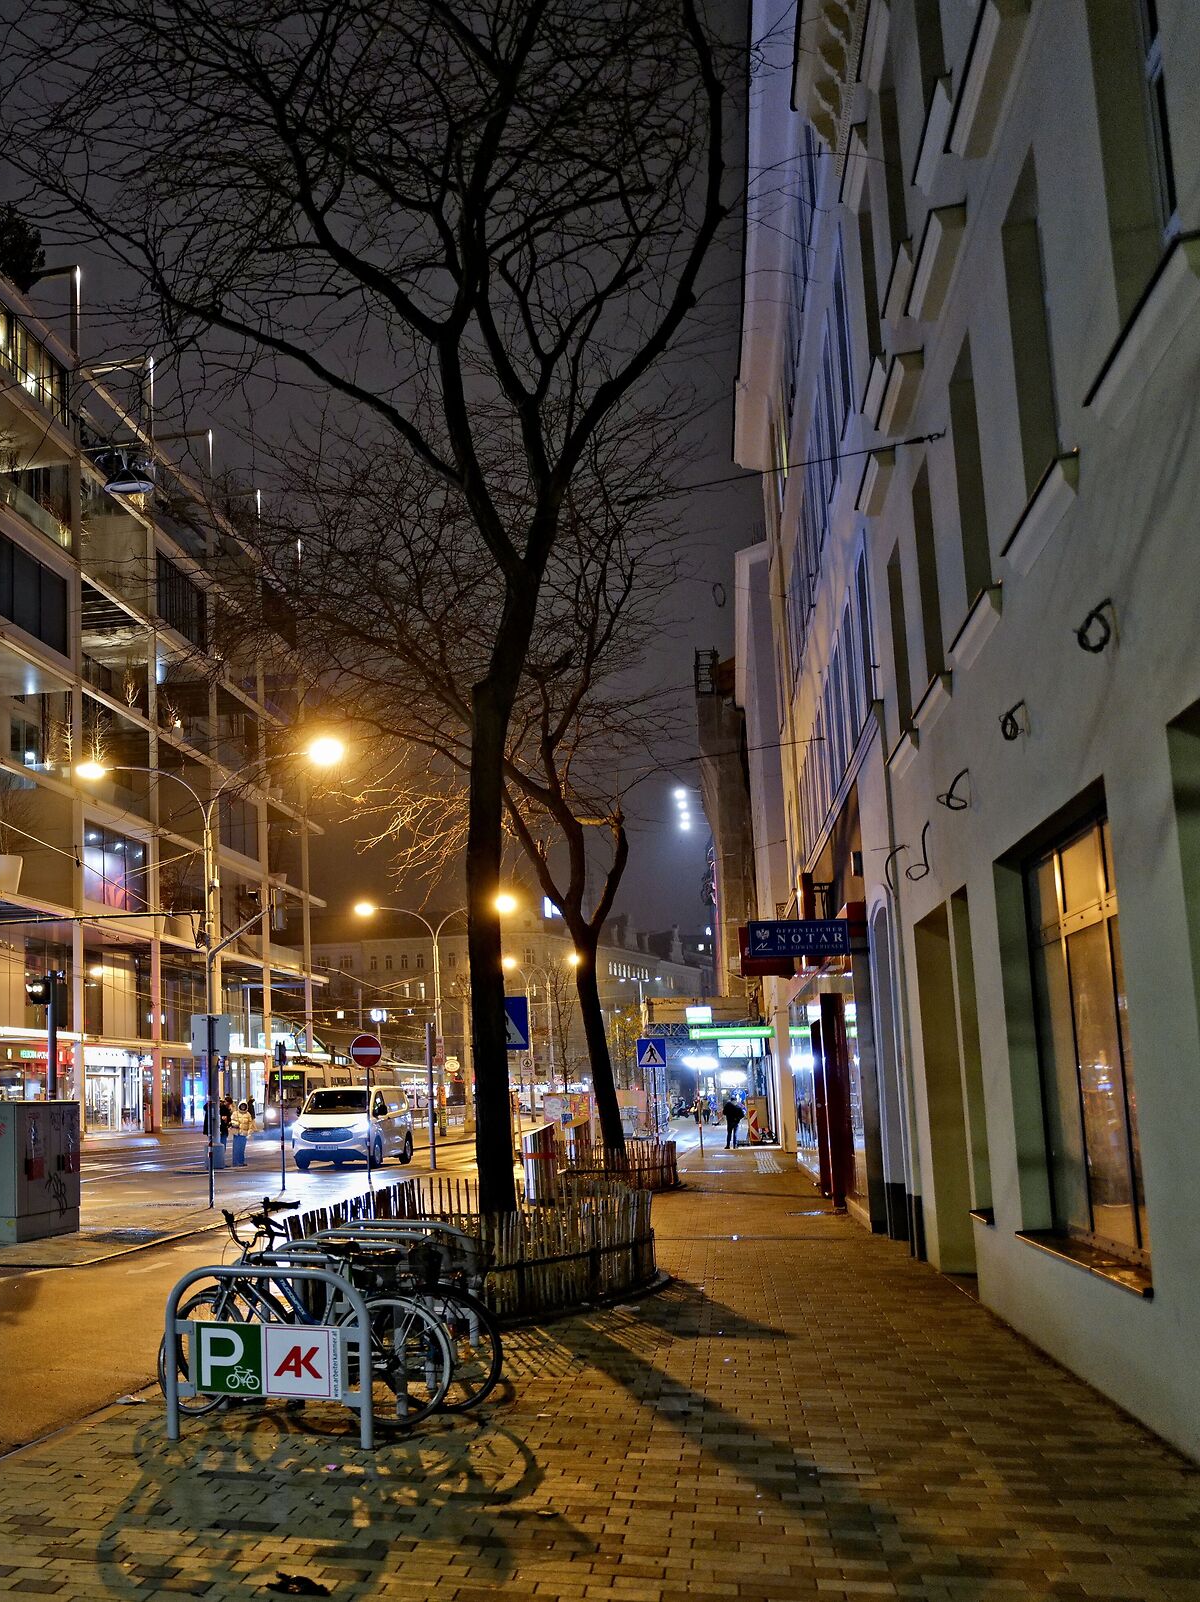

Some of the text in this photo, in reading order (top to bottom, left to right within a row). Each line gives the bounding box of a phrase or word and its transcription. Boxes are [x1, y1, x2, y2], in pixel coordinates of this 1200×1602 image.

[777, 933, 843, 944] NOTAR
[201, 1327, 244, 1387] P
[273, 1345, 323, 1380] AK
